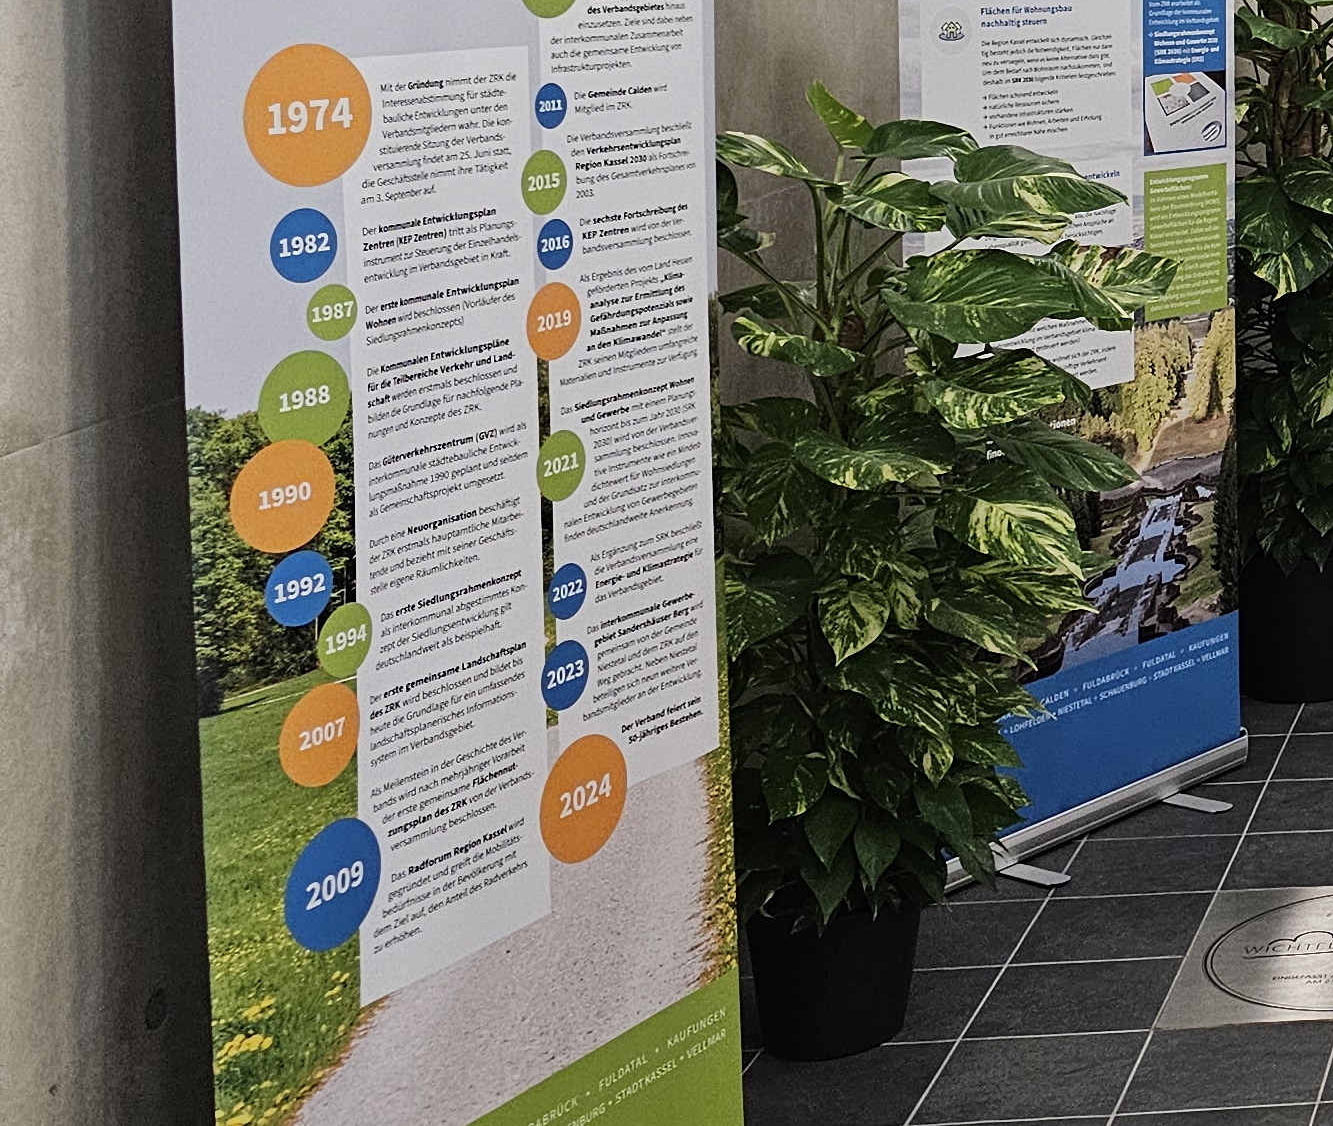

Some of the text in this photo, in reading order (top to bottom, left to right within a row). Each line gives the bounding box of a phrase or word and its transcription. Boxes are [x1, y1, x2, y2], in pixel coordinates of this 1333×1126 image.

[980, 4, 1073, 16] Flächen für Wohnungsbau
[981, 17, 1048, 30] nachhaltig steuern
[267, 97, 354, 136] 1974
[538, 99, 563, 113] 2011
[527, 172, 561, 192] 2015
[278, 232, 331, 258] 1982
[541, 235, 570, 253] 2016
[311, 300, 355, 324] 1987
[537, 309, 572, 333] 2019
[278, 385, 331, 414] 1988
[368, 421, 527, 471] Das Güterverkehrszentrum (GVZ) wird als
[543, 452, 580, 478] 2021
[258, 481, 312, 511] 1990
[273, 573, 326, 604] 1992
[552, 578, 584, 603] 2022
[324, 623, 368, 656] 1994
[1142, 650, 1177, 670] FULDATAL
[1188, 632, 1229, 653] KAUFUNGEN
[369, 641, 527, 705] Der erste gemeinsame Landschaftsplan
[547, 659, 585, 690] 2023
[621, 696, 702, 734] Der Verband feiert sein
[669, 709, 704, 727] Bestehen.
[298, 716, 346, 752] 2007
[559, 772, 612, 819] 2024
[391, 817, 525, 883] Das Radforum Region Kassel wird
[305, 860, 364, 911] 2009
[686, 1028, 727, 1059] VELLMAR
[527, 1095, 579, 1126] ABRÜCK
[598, 1053, 649, 1092] FULDATAL
[667, 1006, 727, 1048] KAUFUNGEN
